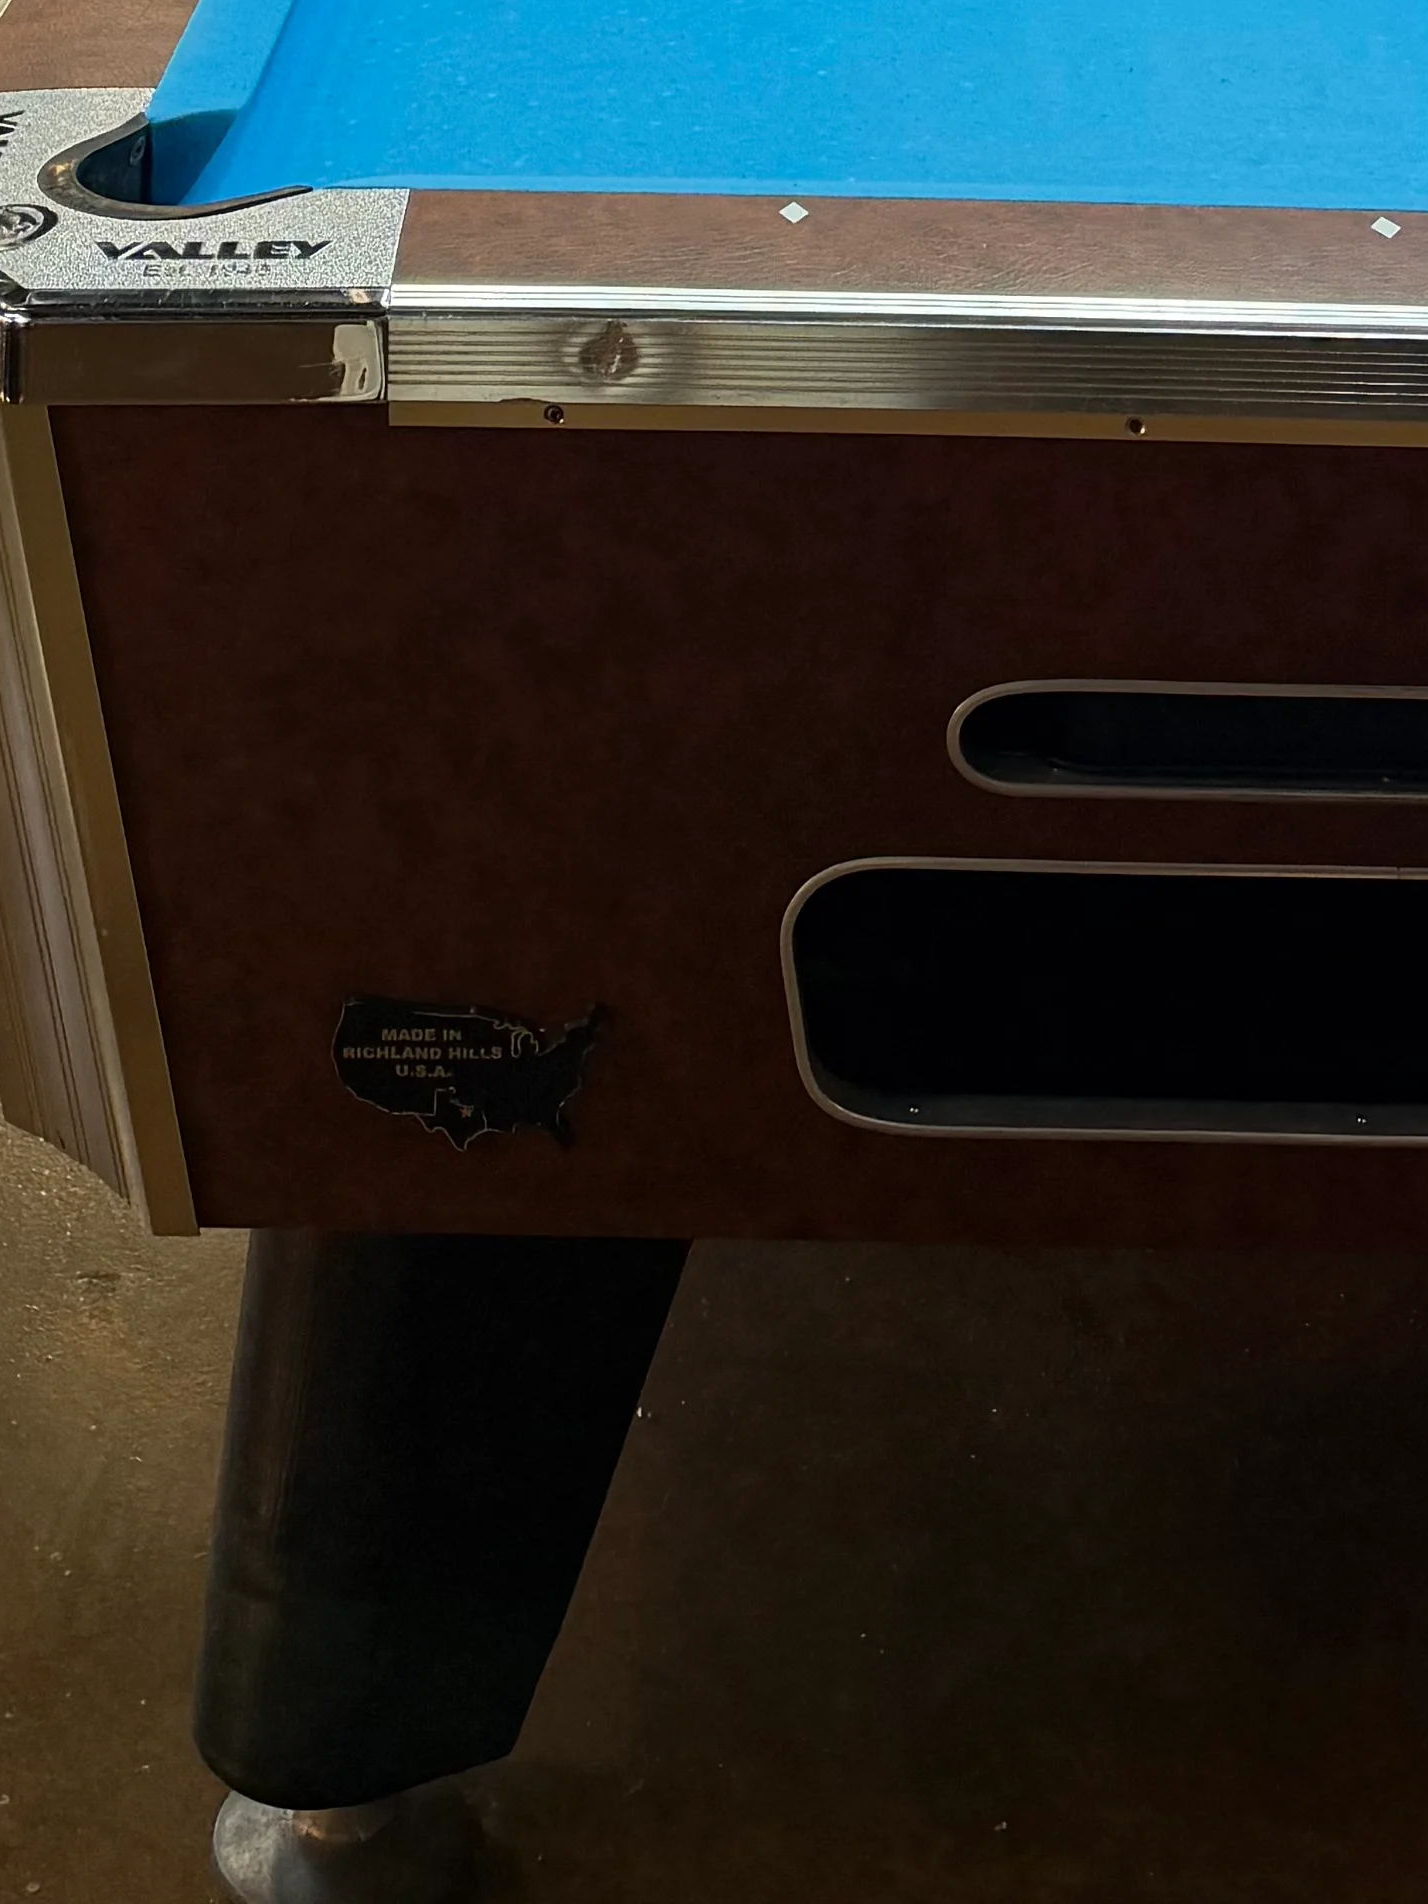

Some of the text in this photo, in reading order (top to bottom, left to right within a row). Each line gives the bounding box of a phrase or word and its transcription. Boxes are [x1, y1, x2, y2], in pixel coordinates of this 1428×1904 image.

[95, 239, 335, 261] VALLEY
[381, 1028, 462, 1042] MADE IN
[343, 1046, 503, 1060] RICHLAND HILLS
